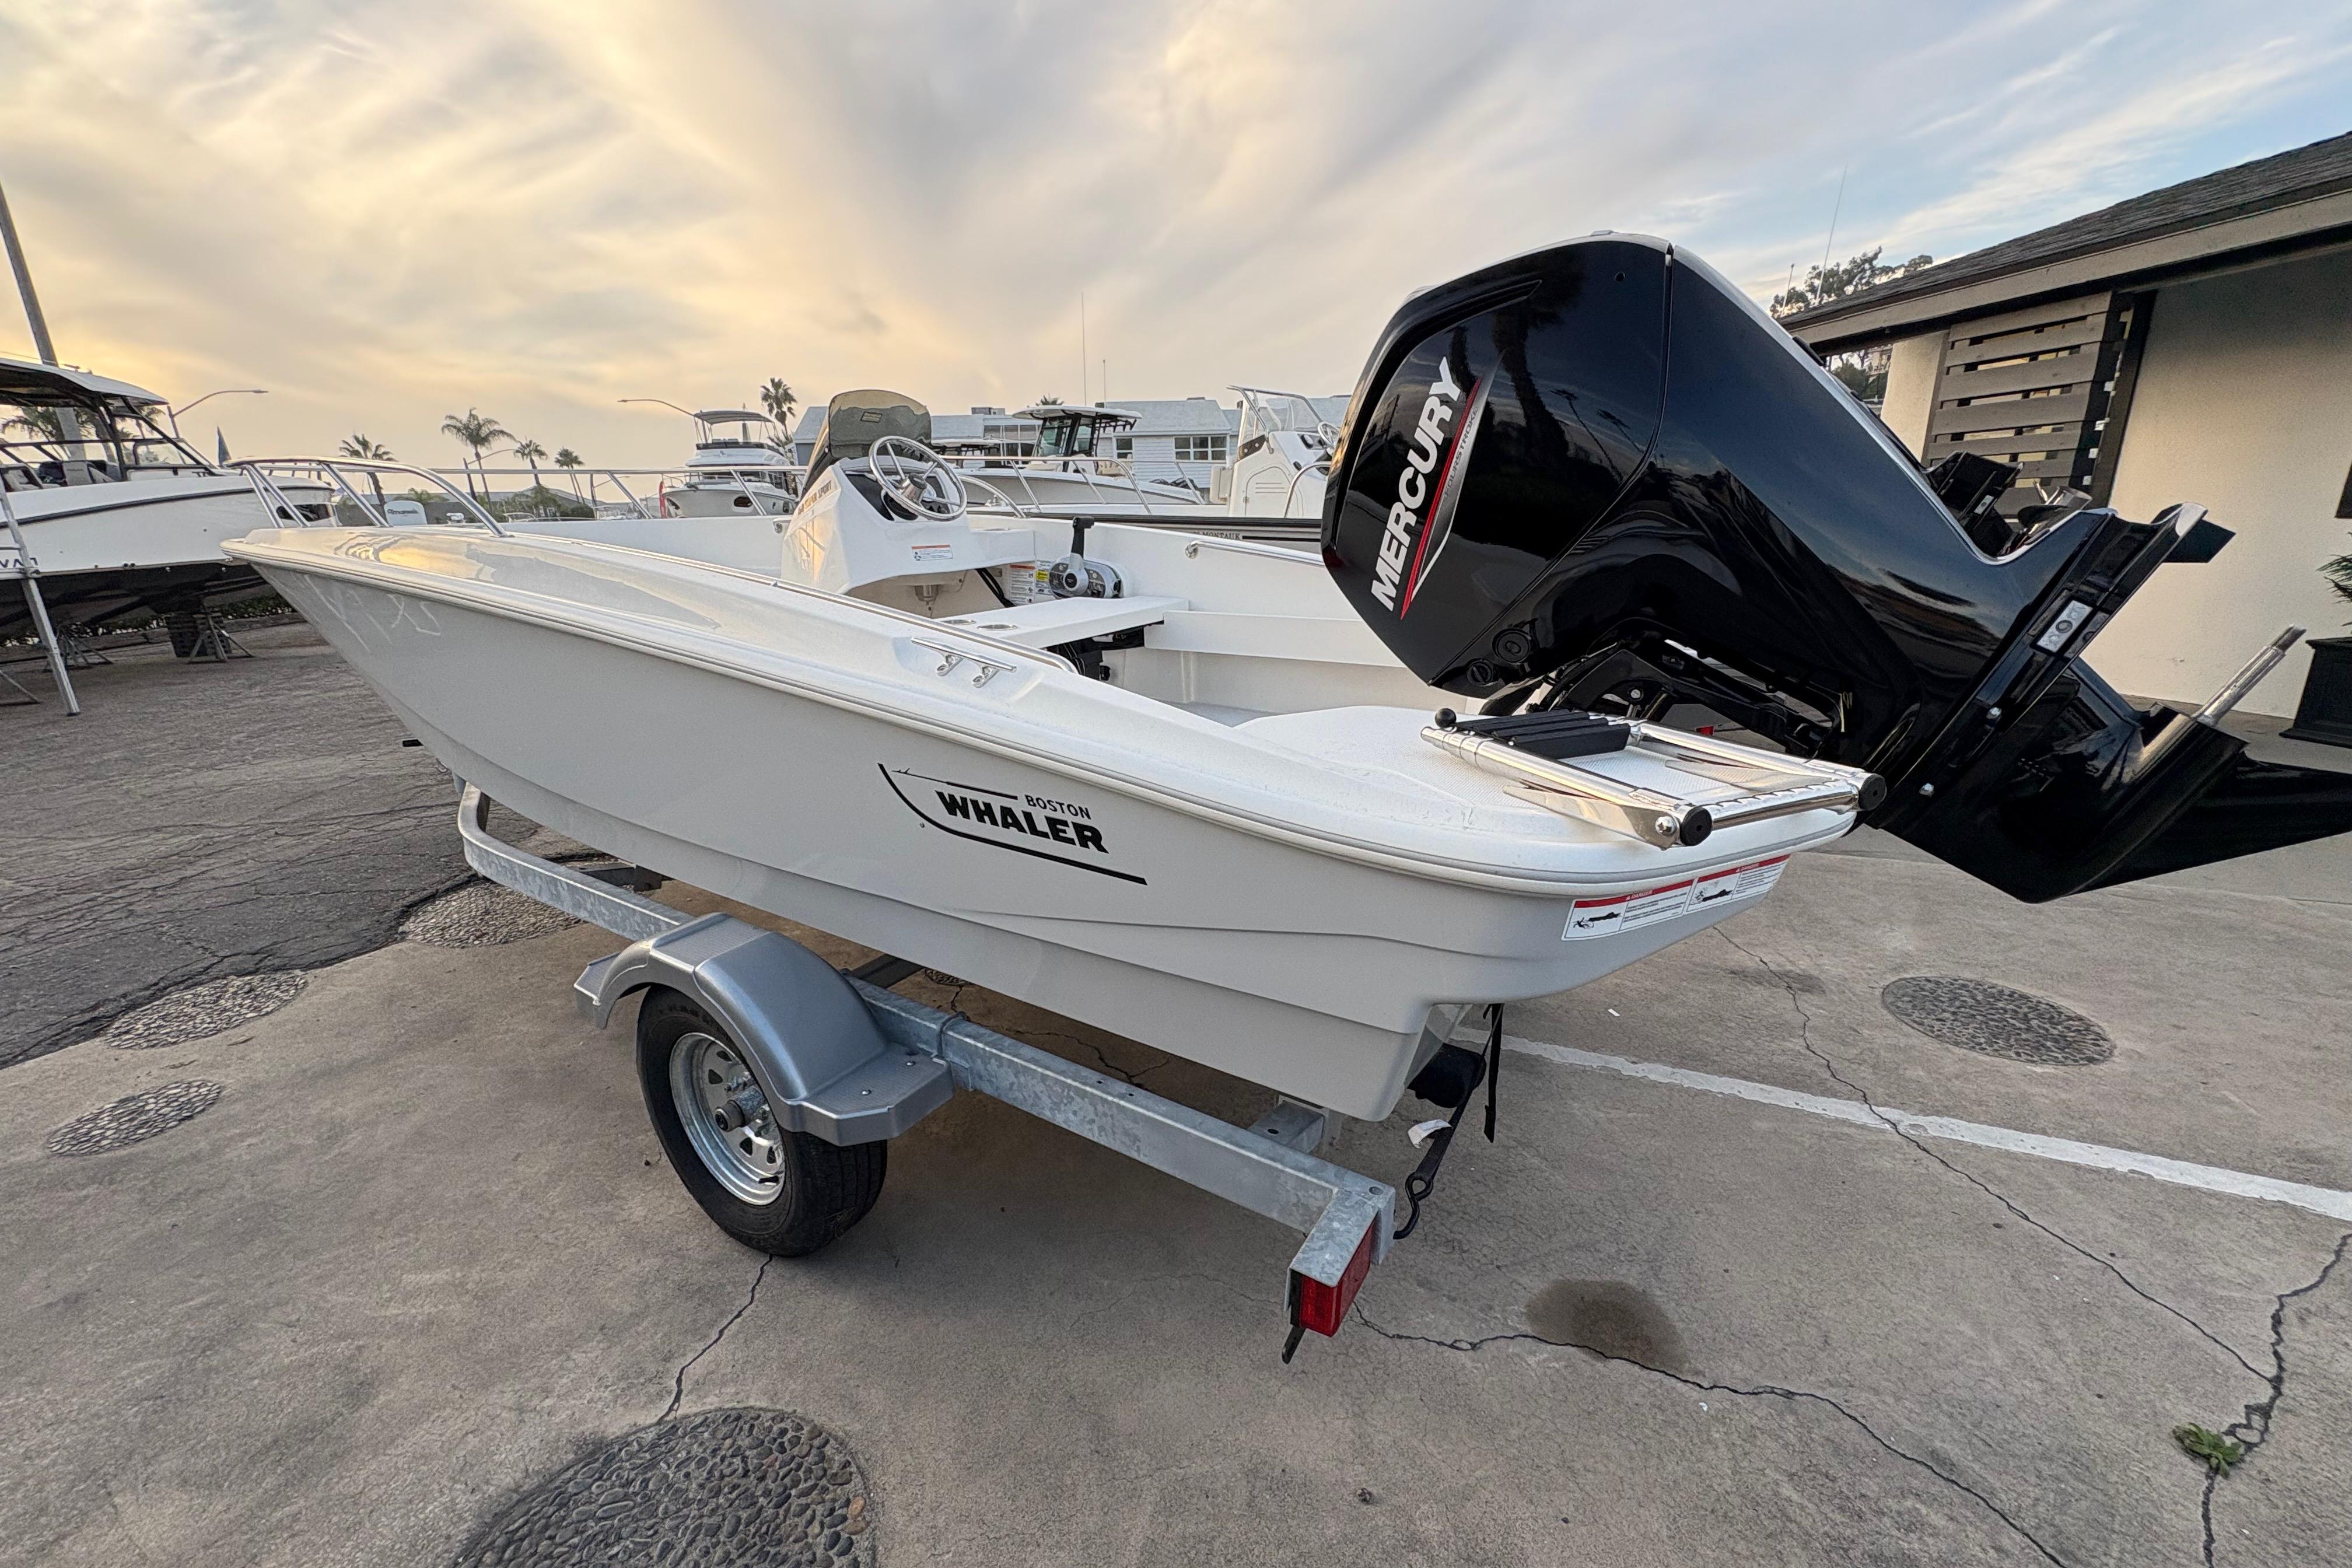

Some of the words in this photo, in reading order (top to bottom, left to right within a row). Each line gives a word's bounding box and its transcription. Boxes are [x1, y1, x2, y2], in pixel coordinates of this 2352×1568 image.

[1444, 405, 1479, 496] FOURSTROKE
[1371, 356, 1461, 612] MERCURY
[1202, 531, 1241, 541] MONTAUK
[935, 790, 1110, 854] WHALER
[1024, 794, 1091, 820] BOSTON
